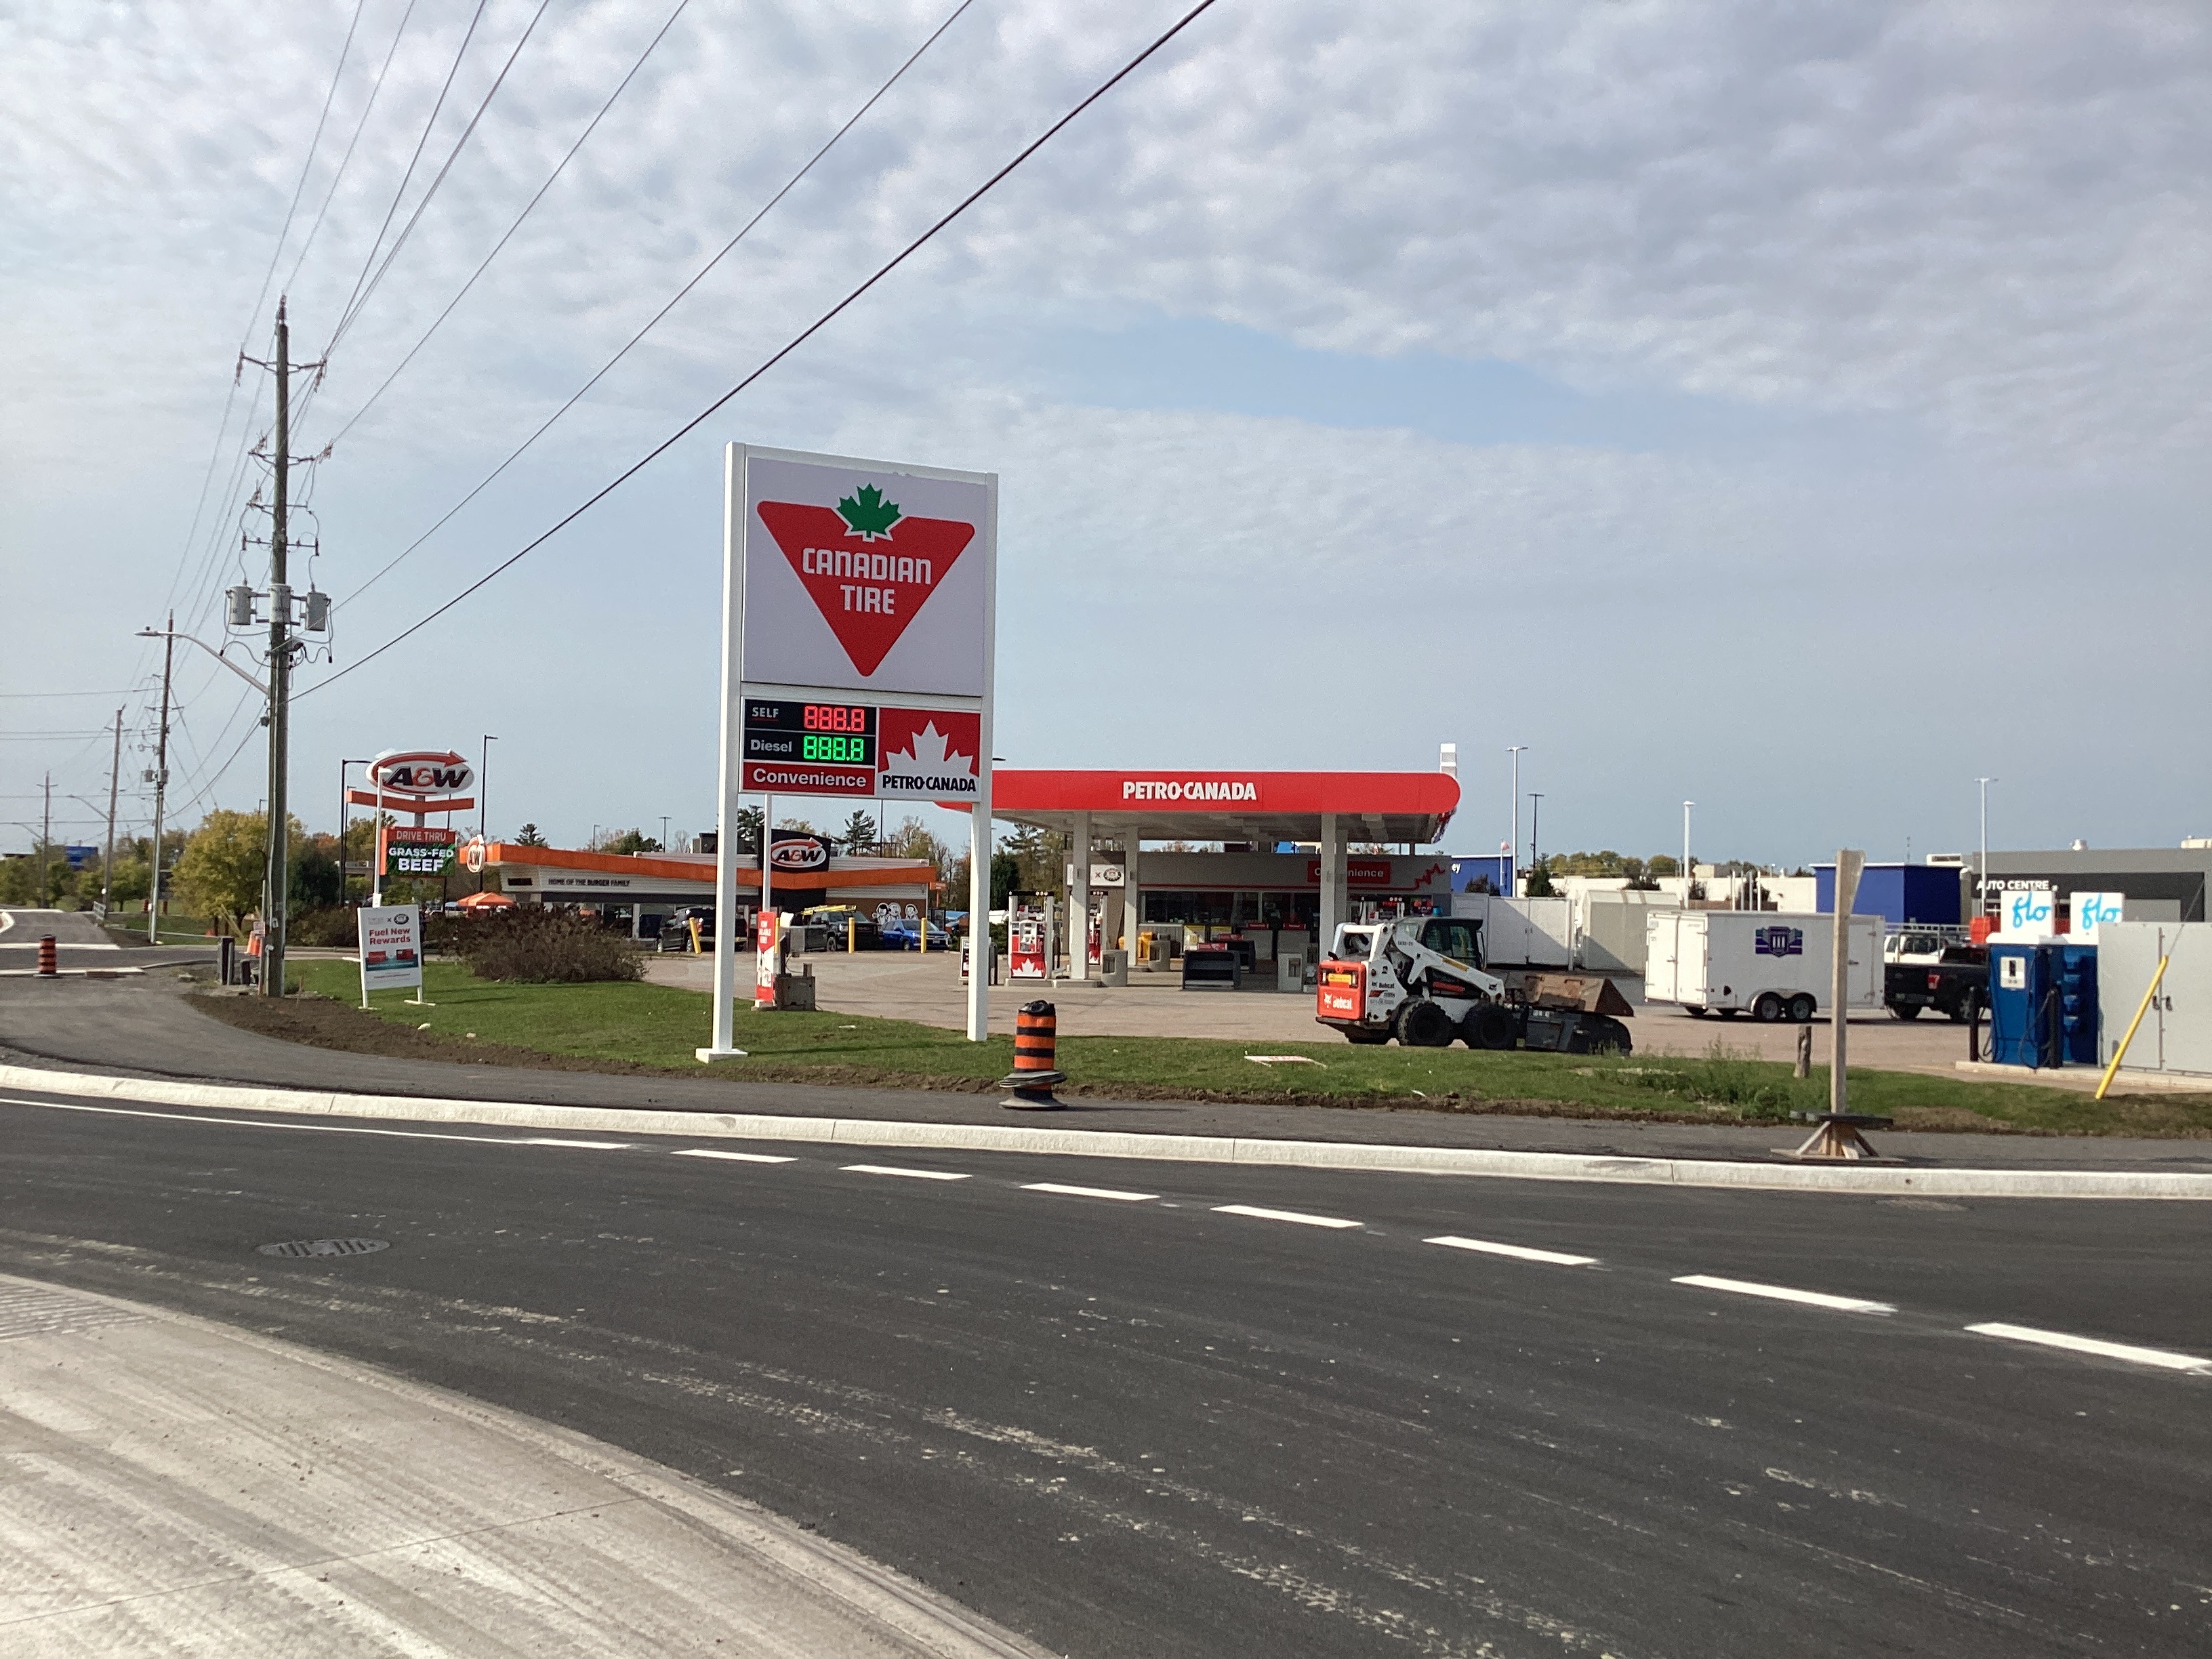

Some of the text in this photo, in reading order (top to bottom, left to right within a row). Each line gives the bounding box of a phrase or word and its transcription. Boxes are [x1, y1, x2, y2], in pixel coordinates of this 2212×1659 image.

[802, 547, 932, 585] CANADIAN
[840, 584, 895, 615] TIRE
[752, 705, 865, 732] SELF 888.8
[750, 735, 864, 762] Diesel 888.8
[384, 766, 469, 788] A&W
[752, 768, 867, 787] Convenience
[396, 830, 447, 842] DRIVE THRU
[388, 847, 454, 857] GRASS-FED
[775, 849, 823, 862] A&W
[398, 857, 444, 872] BEEF
[1314, 867, 1385, 878] Cnience
[1976, 880, 2050, 890] AUTO CENTRE
[2012, 890, 2052, 928] flo
[2082, 893, 2122, 930] flo
[369, 928, 388, 937] Fuel
[369, 935, 411, 945] Rewards
